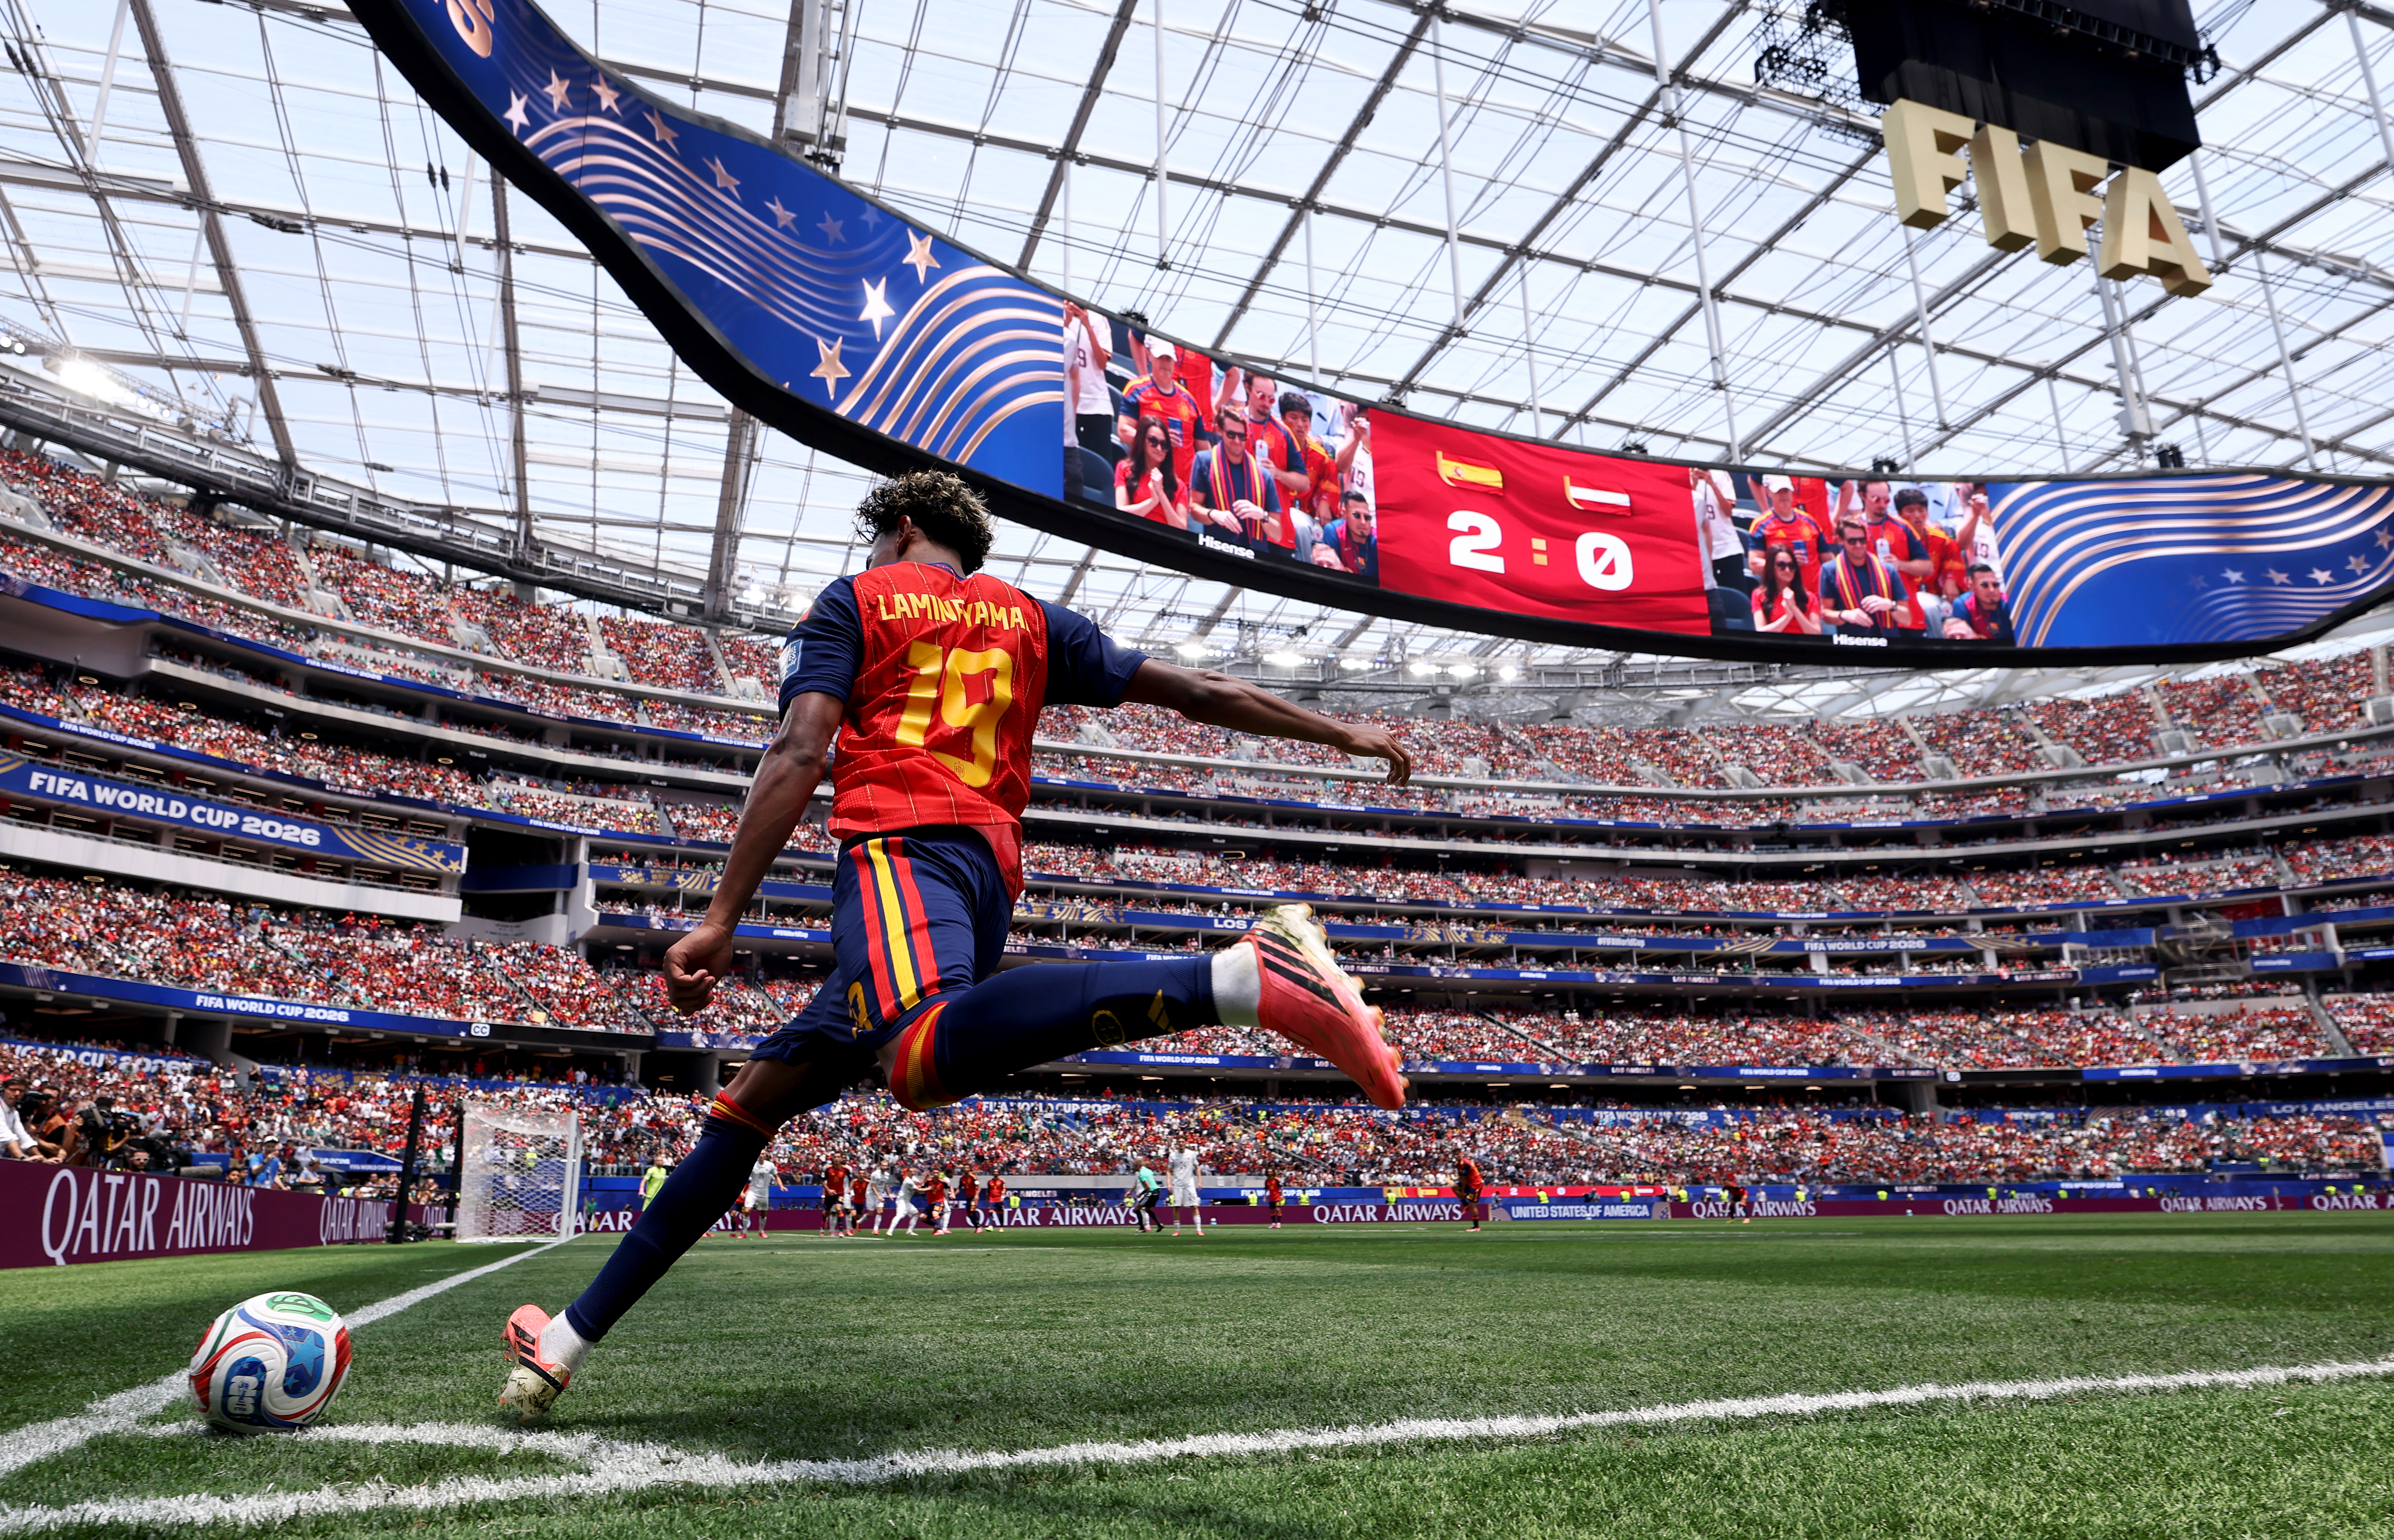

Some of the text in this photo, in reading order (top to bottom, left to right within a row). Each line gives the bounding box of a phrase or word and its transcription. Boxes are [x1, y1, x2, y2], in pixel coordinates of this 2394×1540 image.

[1882, 98, 2213, 298] FIFA
[1198, 533, 1255, 559] Hisense
[1447, 510, 1505, 574] 2
[1575, 531, 1634, 591] 0
[1833, 634, 1888, 646] Hisense
[306, 658, 383, 681] FIFA WORLD CUP 2026
[895, 640, 1013, 788] 19
[59, 721, 156, 750] FIFA WORLD CUP 2026
[29, 771, 320, 846] FIFA WORLD CUP 2026
[1214, 918, 1248, 930] LOS
[1804, 940, 1927, 951] FIFA WORLD CUP 2026
[196, 995, 349, 1022] FIFA WORLD CUP 2026
[1509, 1187, 1518, 1196] 2
[1511, 1205, 1650, 1218] UNITED STATES OF AMERICA
[1752, 1201, 1817, 1216] AIRWAYS
[1943, 1198, 2053, 1216] QATAR AIRWAYS
[2160, 1197, 2203, 1213] QATAR
[2313, 1194, 2380, 1212] QATAR
[41, 1169, 255, 1266] QATAR AIRWAYS
[319, 1196, 355, 1246] QATAR
[1049, 1207, 1139, 1225] AIRWAYS
[1313, 1204, 1463, 1224] QATAR AIRWAYS
